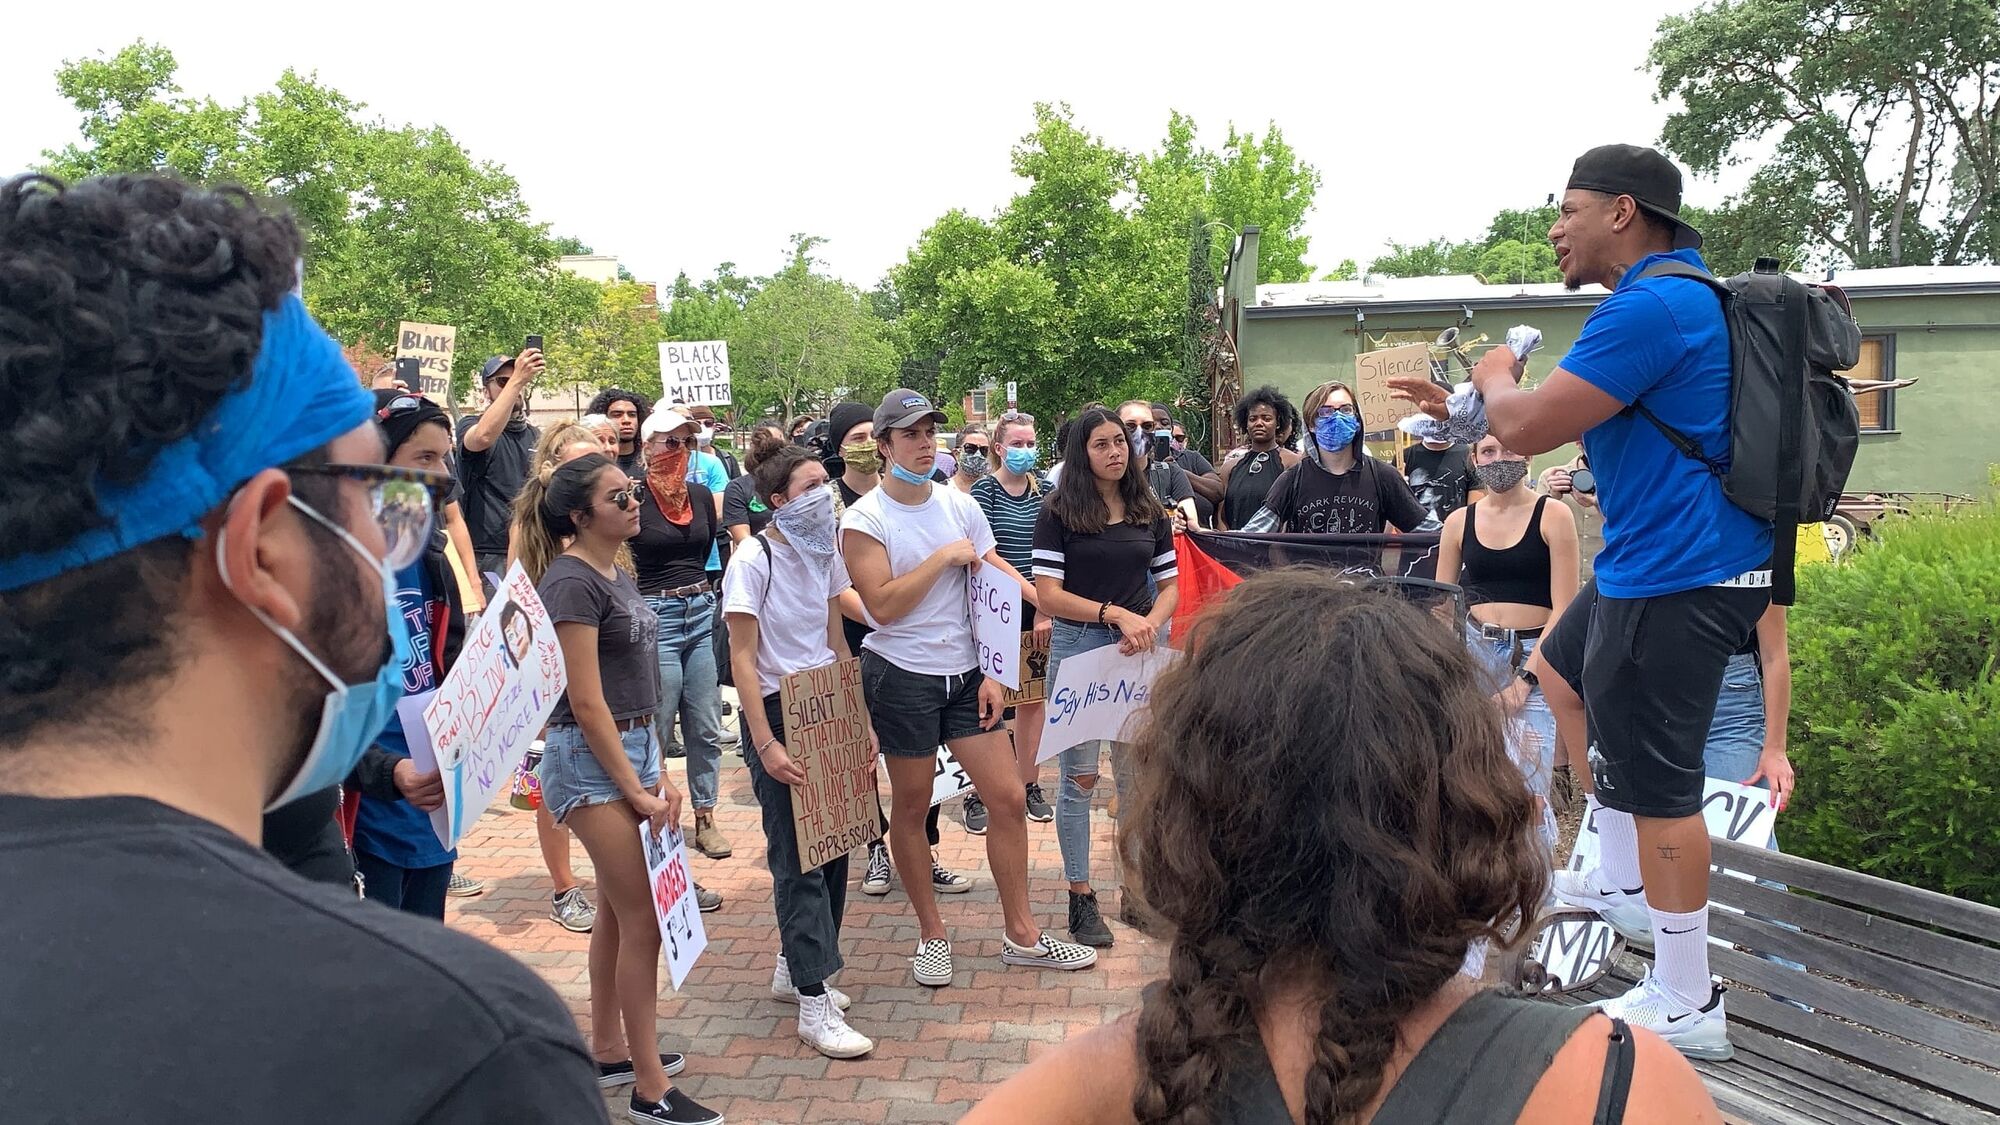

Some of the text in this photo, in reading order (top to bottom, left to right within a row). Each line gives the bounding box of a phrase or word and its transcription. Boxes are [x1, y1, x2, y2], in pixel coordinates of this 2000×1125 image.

[402, 331, 452, 353] BLACK
[668, 344, 723, 364] BLACK
[677, 365, 721, 381] LIVES
[1360, 356, 1424, 381] Silence
[671, 383, 730, 402] MATTER
[1364, 411, 1384, 426] Do
[1333, 495, 1374, 512] REVIVAL
[428, 620, 496, 737] IS JUSTICE
[785, 660, 861, 702] IF YOU ARE
[788, 688, 859, 730] SILENT IN
[1050, 687, 1081, 725] Say
[791, 713, 863, 758] SITUATIONS
[477, 759, 497, 796] NO
[794, 781, 820, 814] YOU
[823, 774, 849, 806] HAVE
[799, 795, 869, 840] THE SIDE OF
[808, 818, 877, 866] OPPRESSOR
